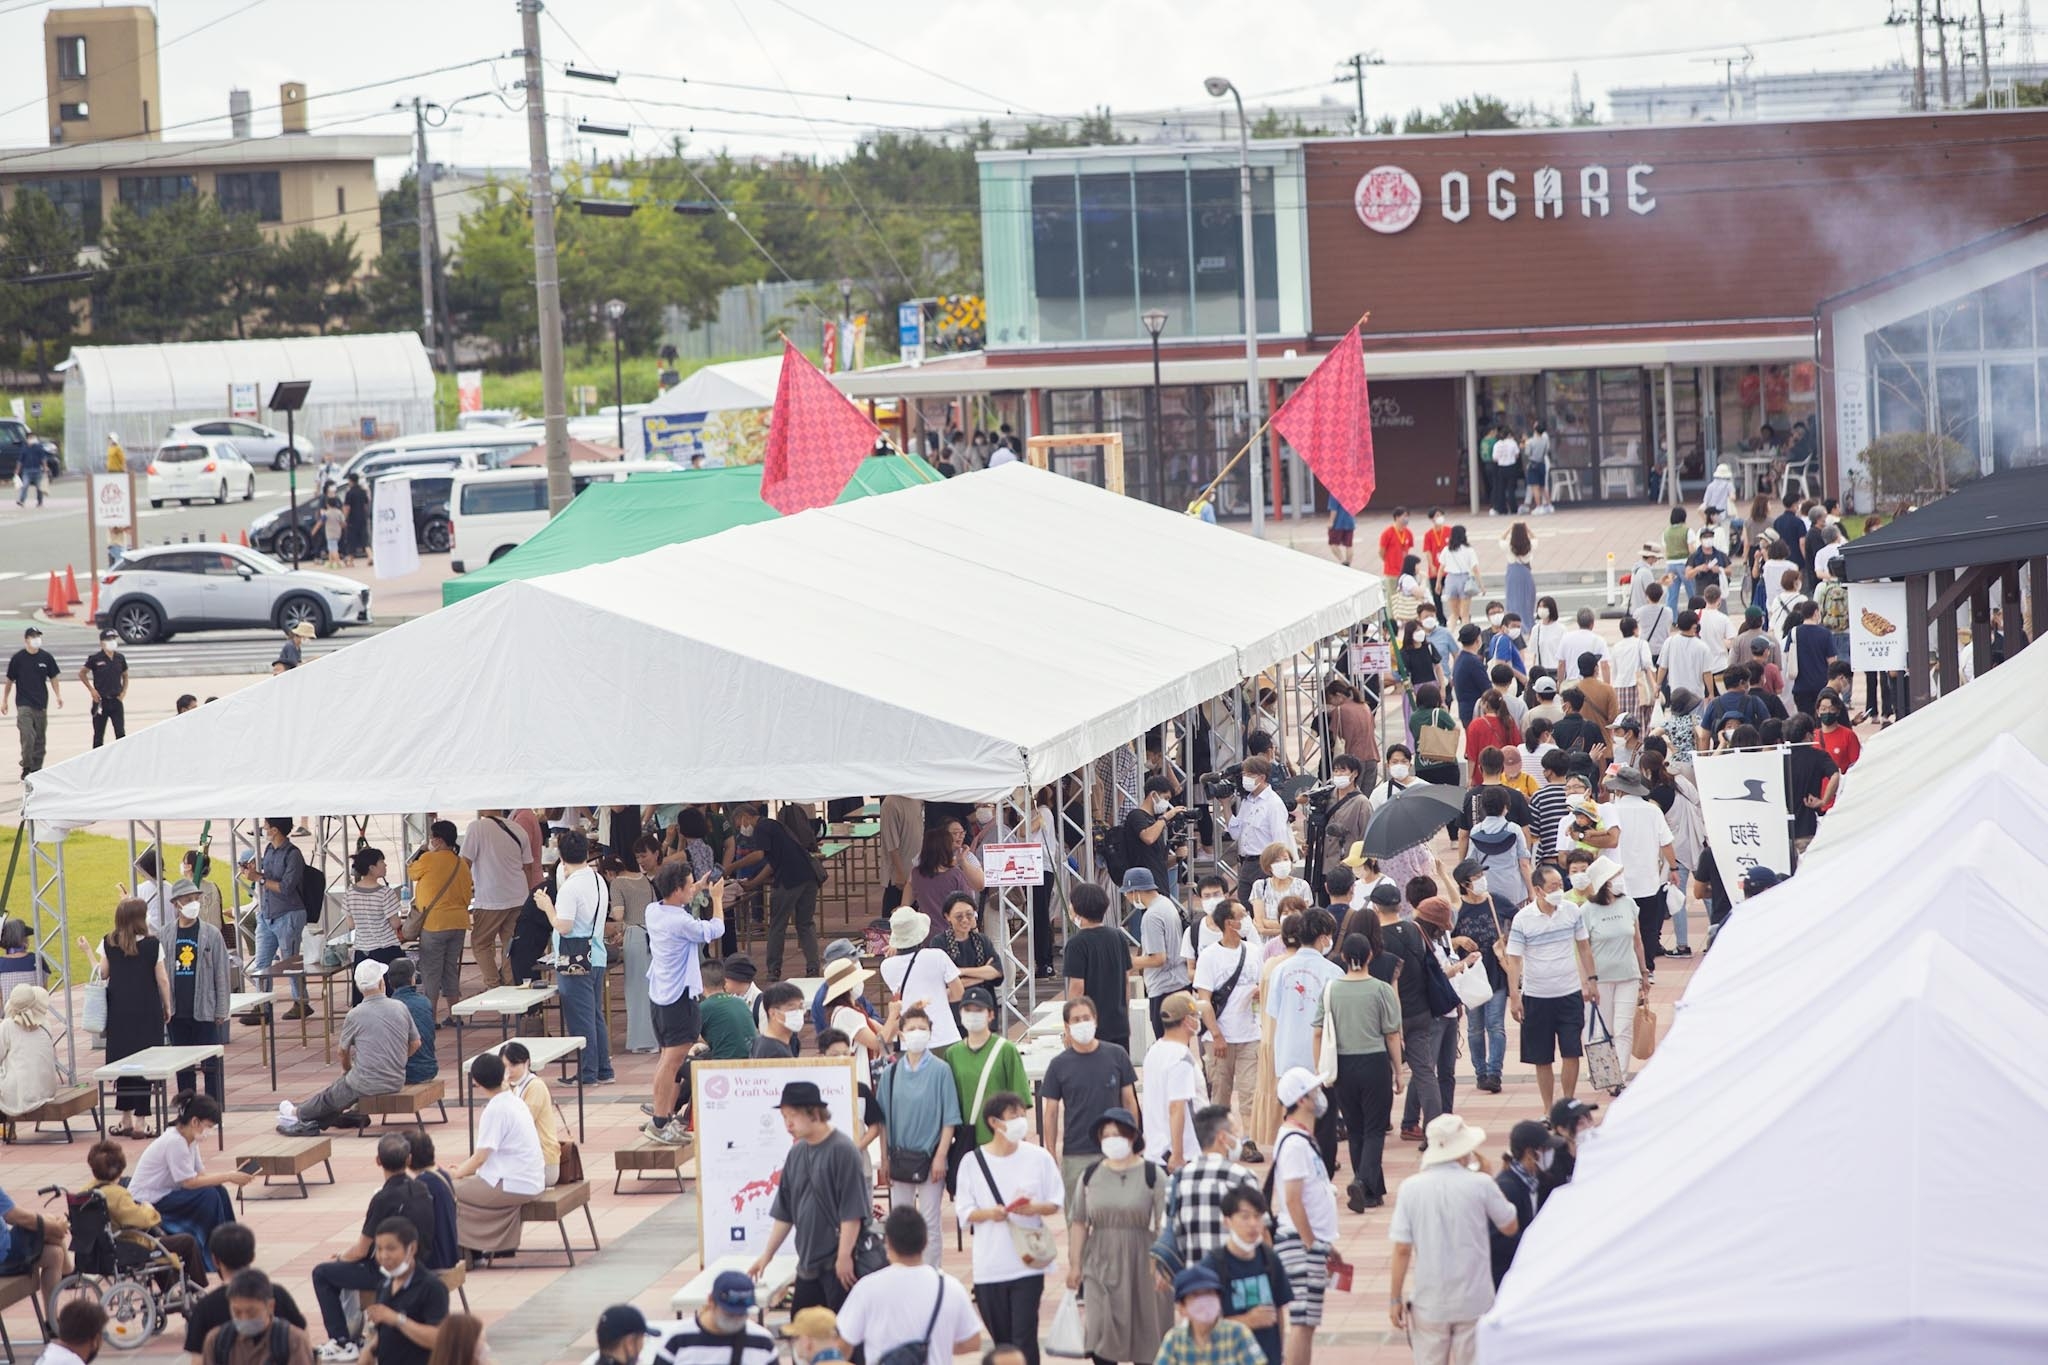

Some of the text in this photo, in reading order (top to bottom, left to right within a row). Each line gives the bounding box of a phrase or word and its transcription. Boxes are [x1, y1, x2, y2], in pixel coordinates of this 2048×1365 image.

[1441, 165, 1656, 223] OGARE
[734, 1077, 751, 1086] We
[734, 1087, 760, 1097] Craft
[762, 1086, 780, 1097] Sak
